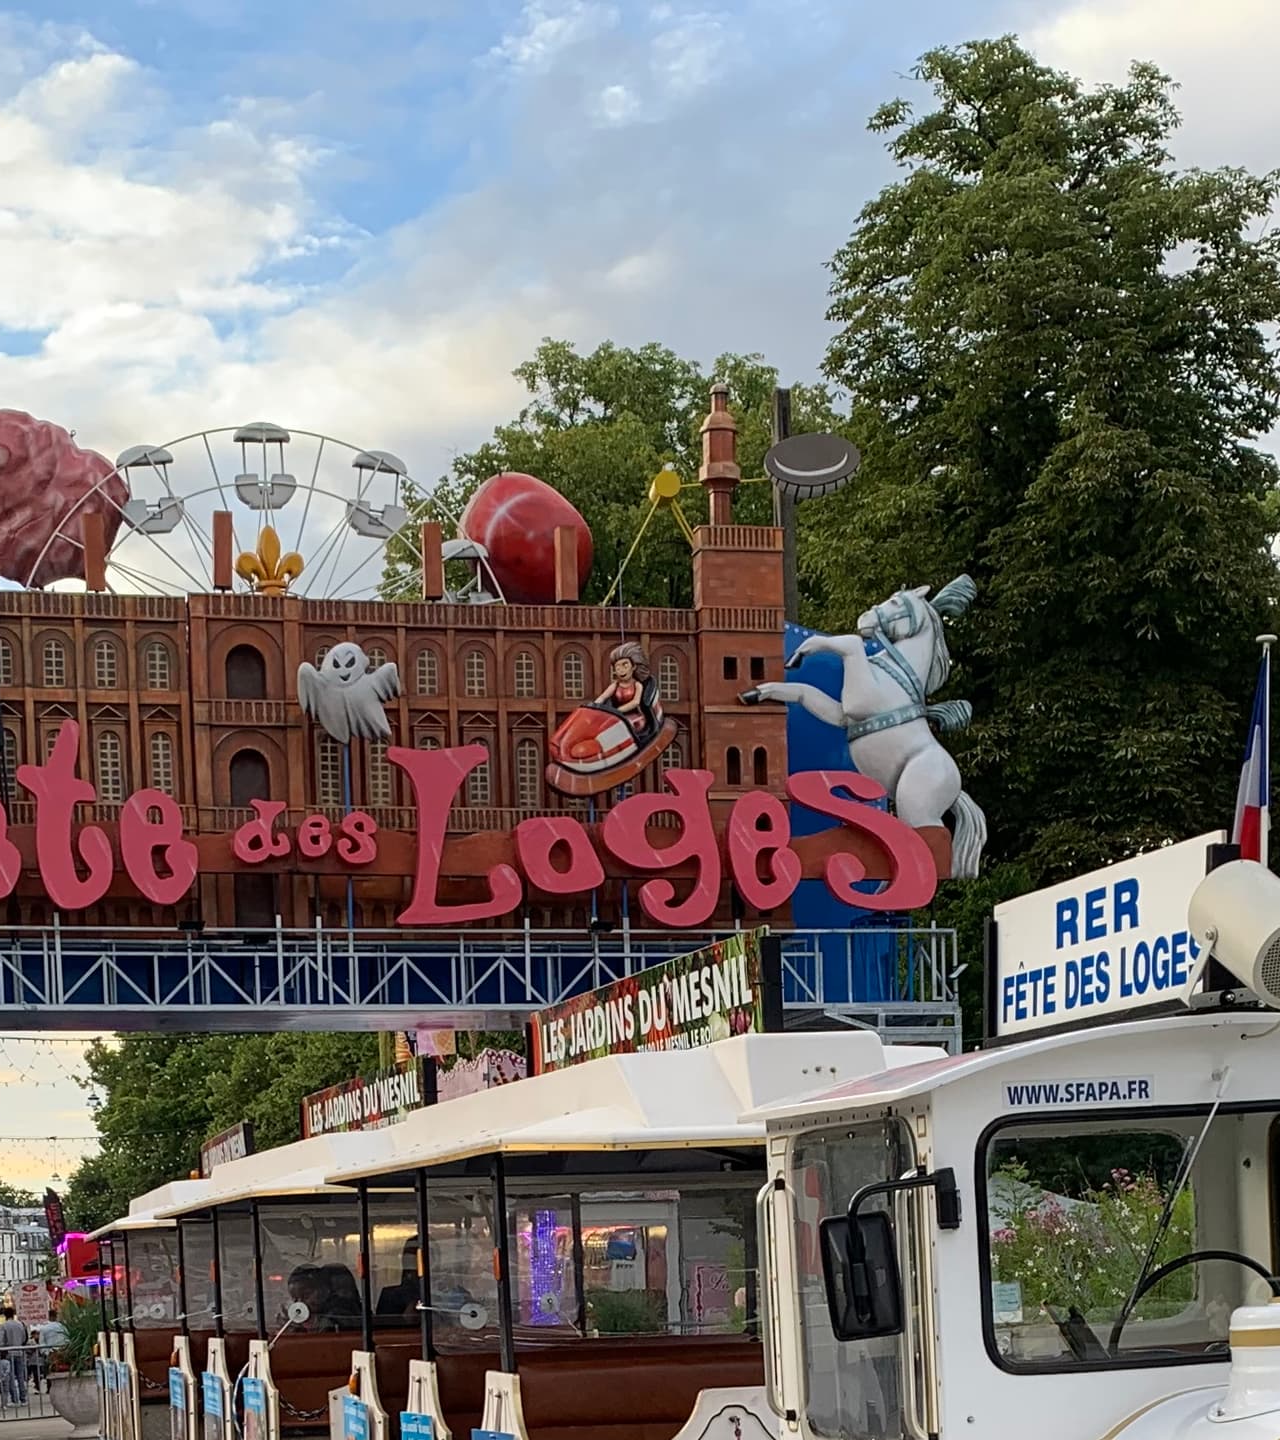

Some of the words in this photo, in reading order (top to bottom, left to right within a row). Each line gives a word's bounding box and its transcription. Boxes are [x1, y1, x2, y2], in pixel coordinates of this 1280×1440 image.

[233, 799, 377, 864] des
[386, 744, 938, 927] Loges
[1056, 878, 1139, 949] RER
[542, 1018, 565, 1063] LES
[569, 994, 634, 1057] JARDINS
[673, 954, 752, 1026] MESNIL
[1003, 960, 1056, 1024] FÊTE
[1065, 951, 1110, 1010] DES
[691, 1029, 699, 1047] LE
[309, 1103, 323, 1134] LES
[324, 1091, 362, 1129] JARDINS
[379, 1070, 420, 1112] MESNIL
[1007, 1080, 1149, 1105] WWW.SFAPA.FR
